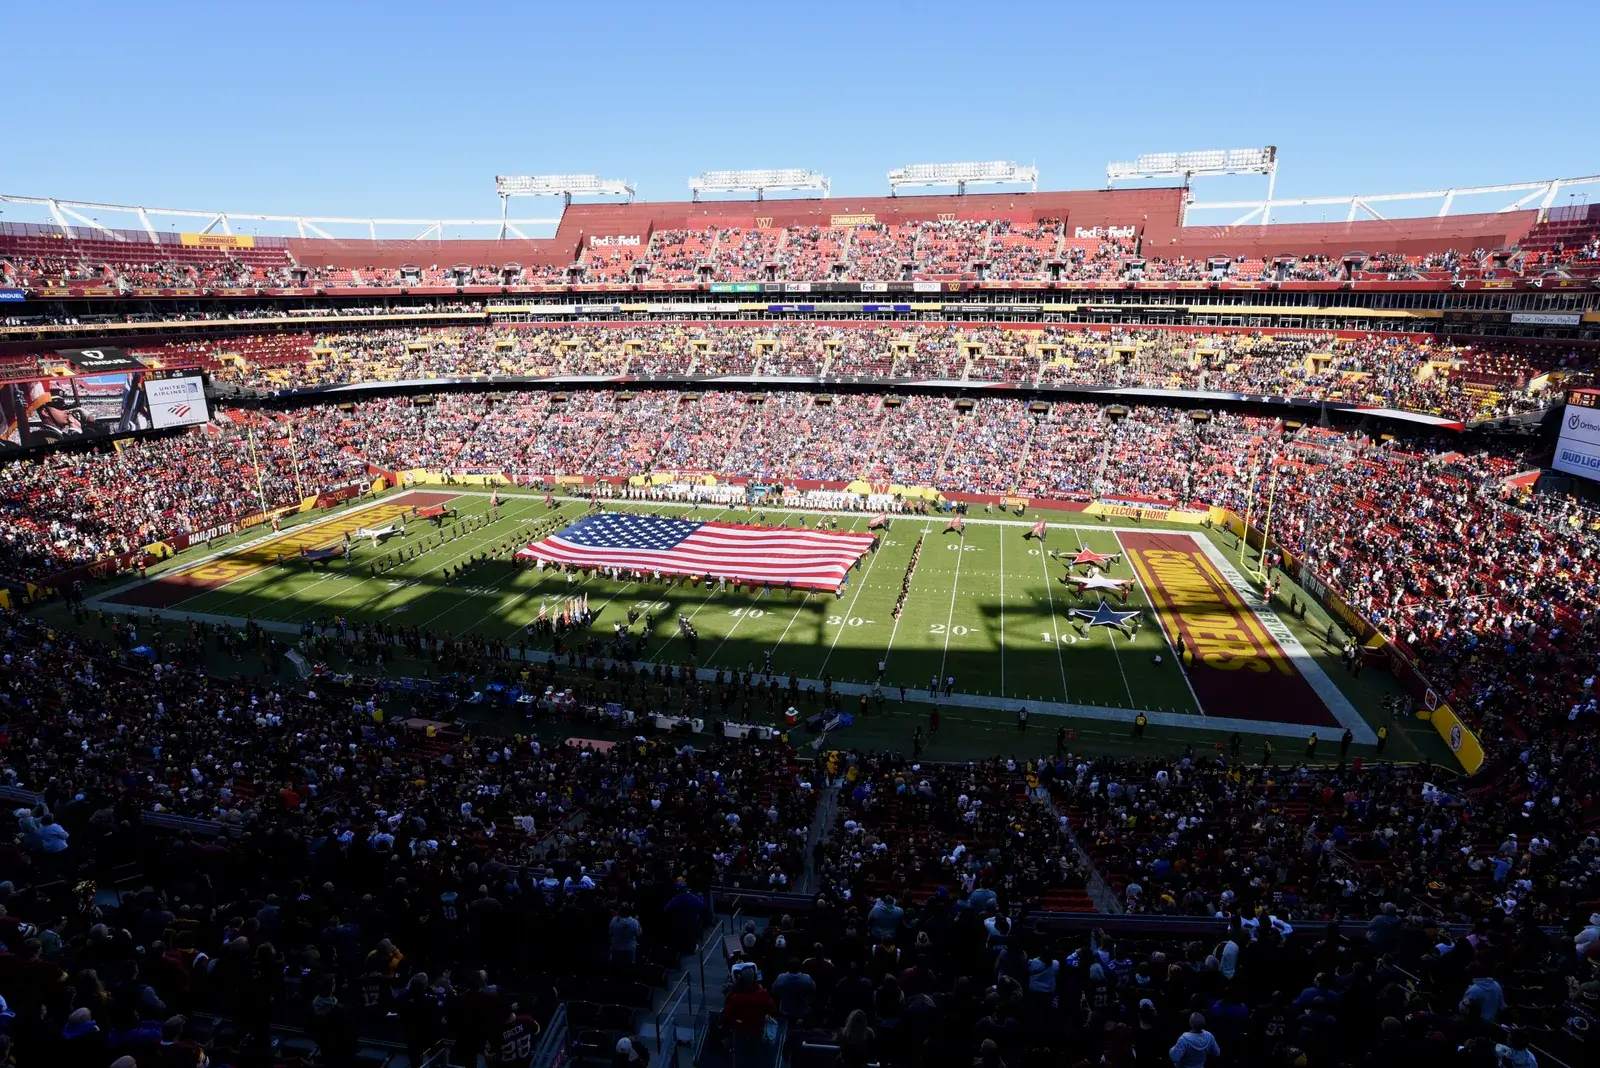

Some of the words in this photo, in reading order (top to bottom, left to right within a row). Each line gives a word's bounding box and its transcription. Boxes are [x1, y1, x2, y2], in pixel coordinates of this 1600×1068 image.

[831, 216, 876, 225] COMMANDERS
[1075, 225, 1135, 238] FedExField
[198, 235, 238, 245] COMMANDERS
[590, 235, 640, 246] FedExField
[1562, 451, 1581, 464] BUD
[1143, 510, 1169, 520] HOME
[188, 532, 208, 546] HAIL
[219, 523, 232, 536] THE
[634, 600, 671, 610] 50
[1143, 549, 1271, 673] COMMANDERS
[728, 608, 764, 619] 40
[826, 615, 864, 627] 30
[1254, 607, 1297, 644] SERVICE
[929, 623, 968, 636] 20
[1040, 632, 1077, 645] 10
[503, 1023, 524, 1040] GREEN
